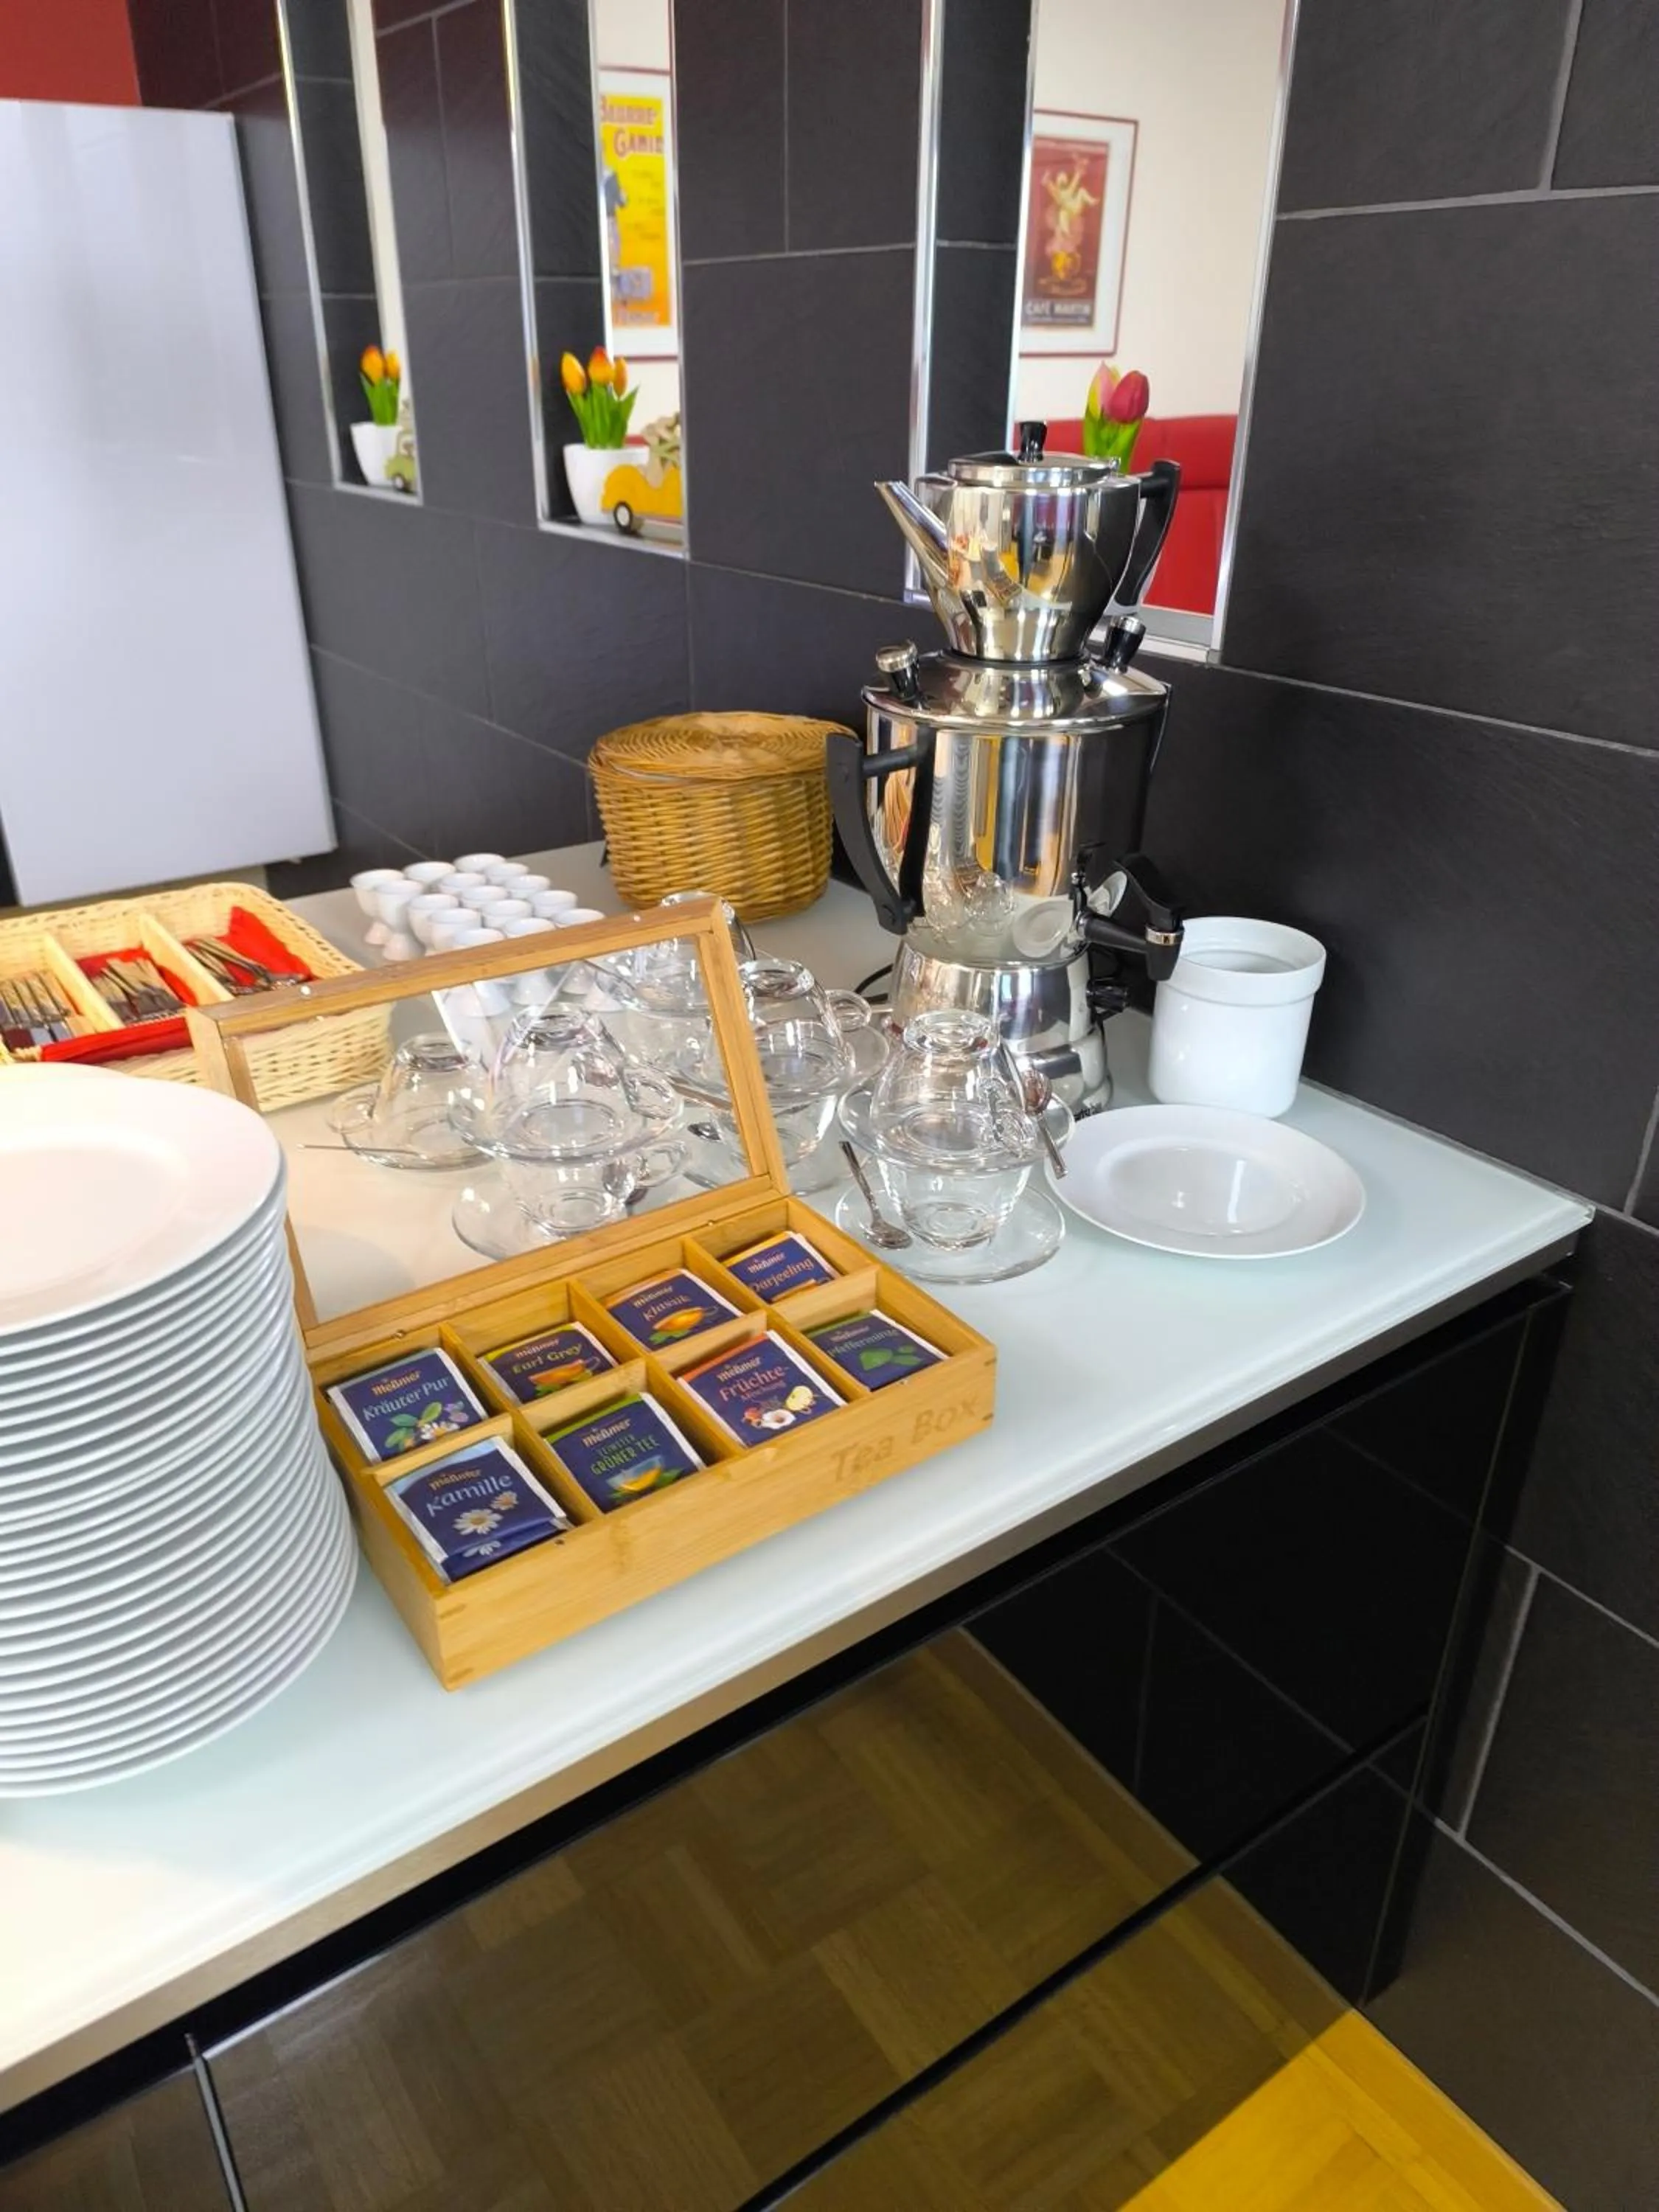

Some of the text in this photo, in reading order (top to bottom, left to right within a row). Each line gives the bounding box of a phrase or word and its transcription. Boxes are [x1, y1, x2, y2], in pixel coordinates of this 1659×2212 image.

[512, 1343, 582, 1374] Earl Grey
[362, 1377, 450, 1422] Kräuter Pur
[635, 1434, 660, 1453] TEE
[830, 1436, 895, 1482] Tea
[425, 1475, 514, 1517] Kamille
